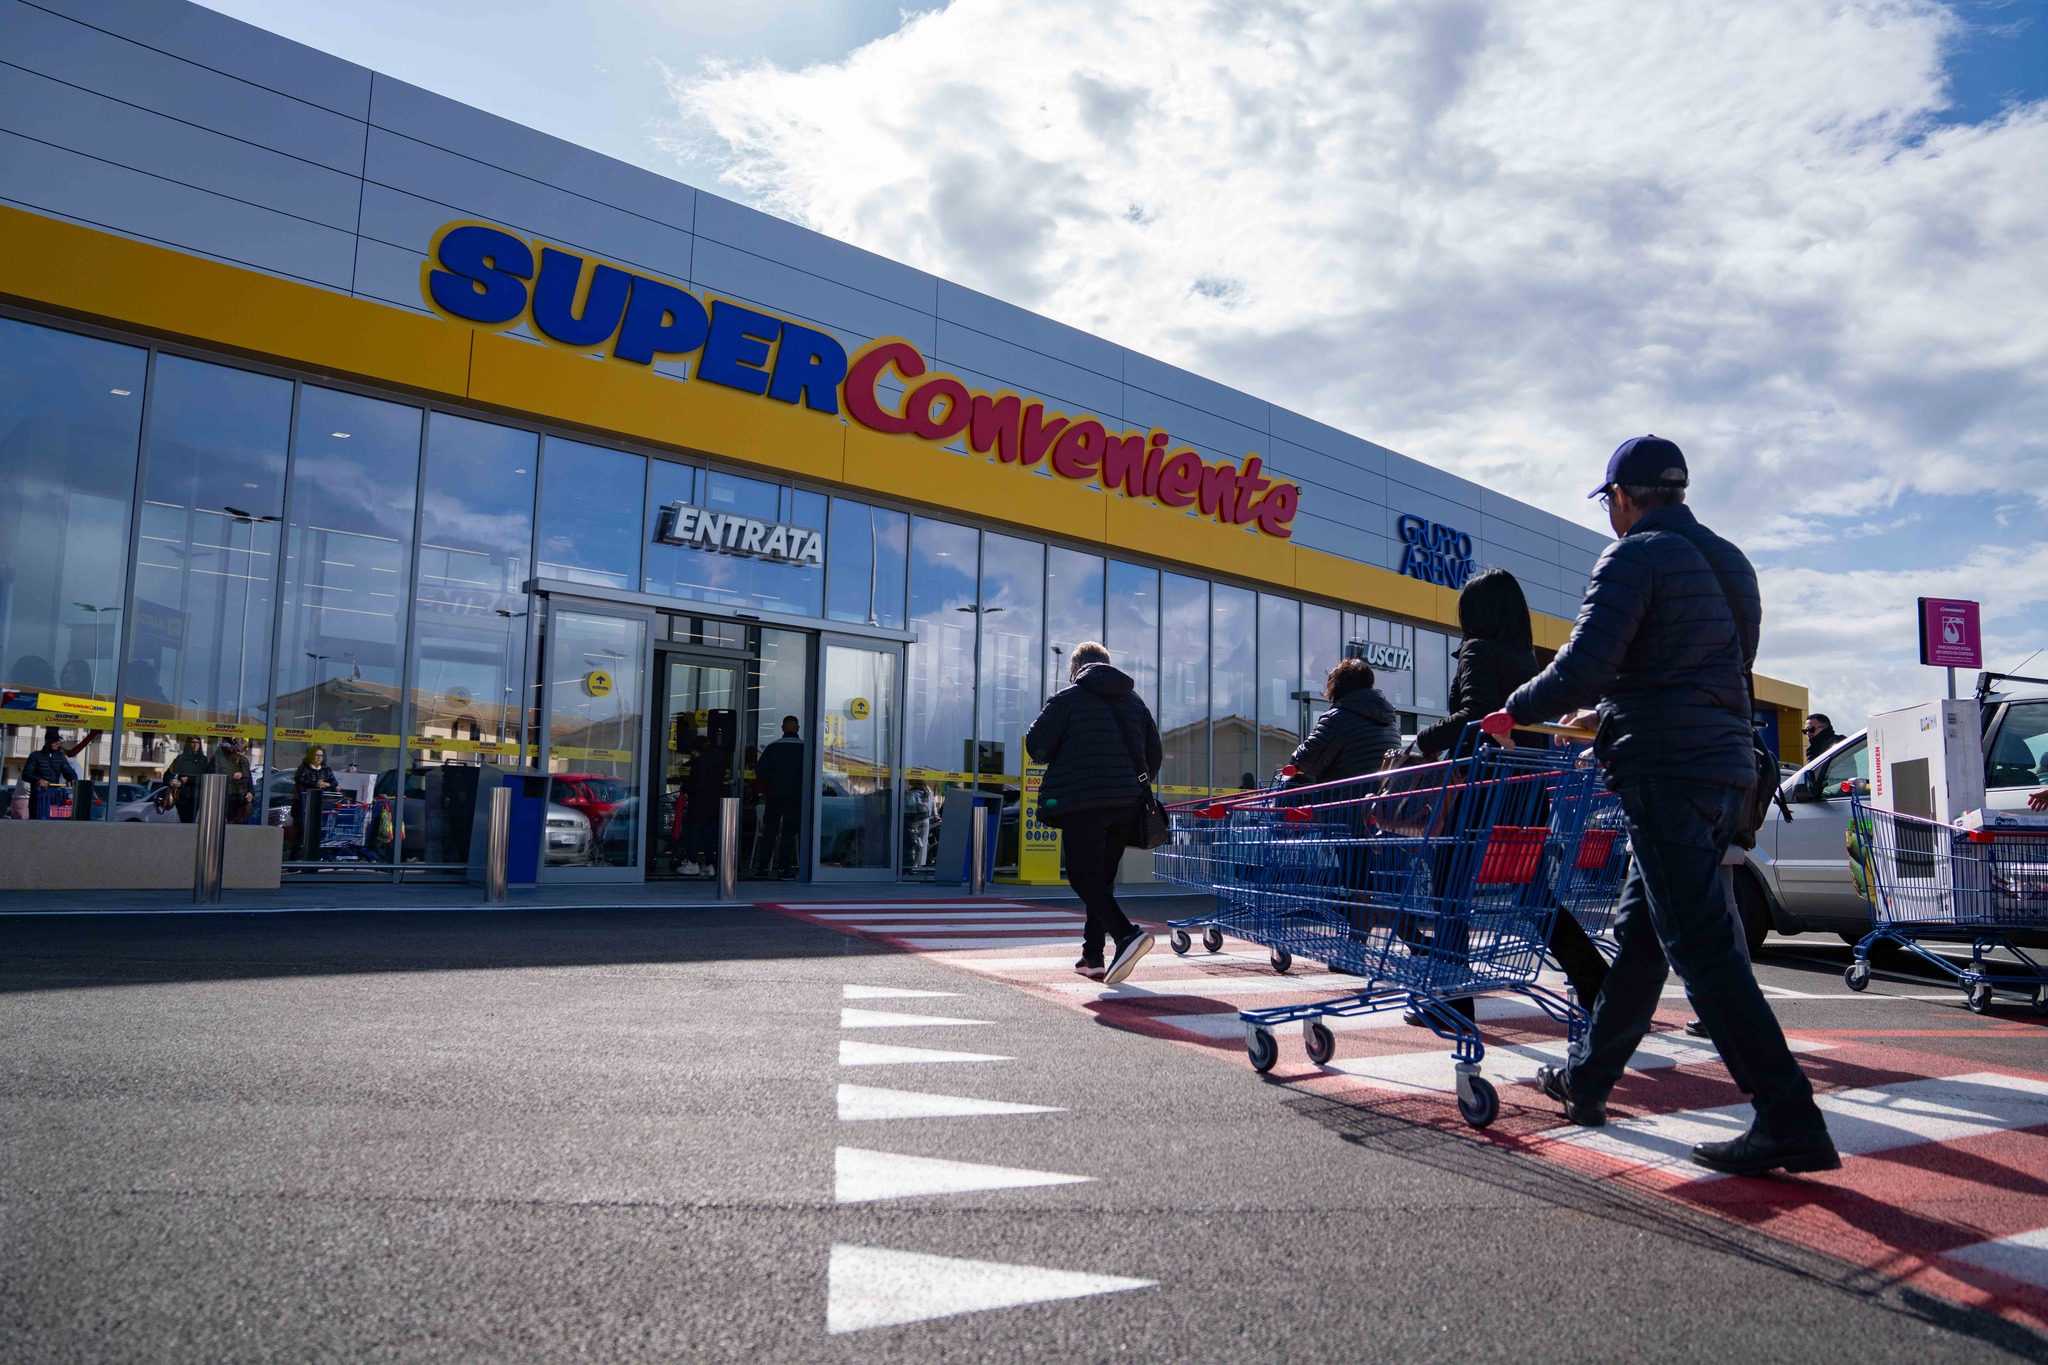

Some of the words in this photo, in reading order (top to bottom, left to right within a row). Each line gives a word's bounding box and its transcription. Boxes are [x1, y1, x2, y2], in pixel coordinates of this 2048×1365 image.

[672, 505, 823, 564] ENTRATA
[1400, 513, 1472, 560] GRUPPO
[1400, 545, 1470, 590] ARENA
[1367, 644, 1413, 670] USCITA
